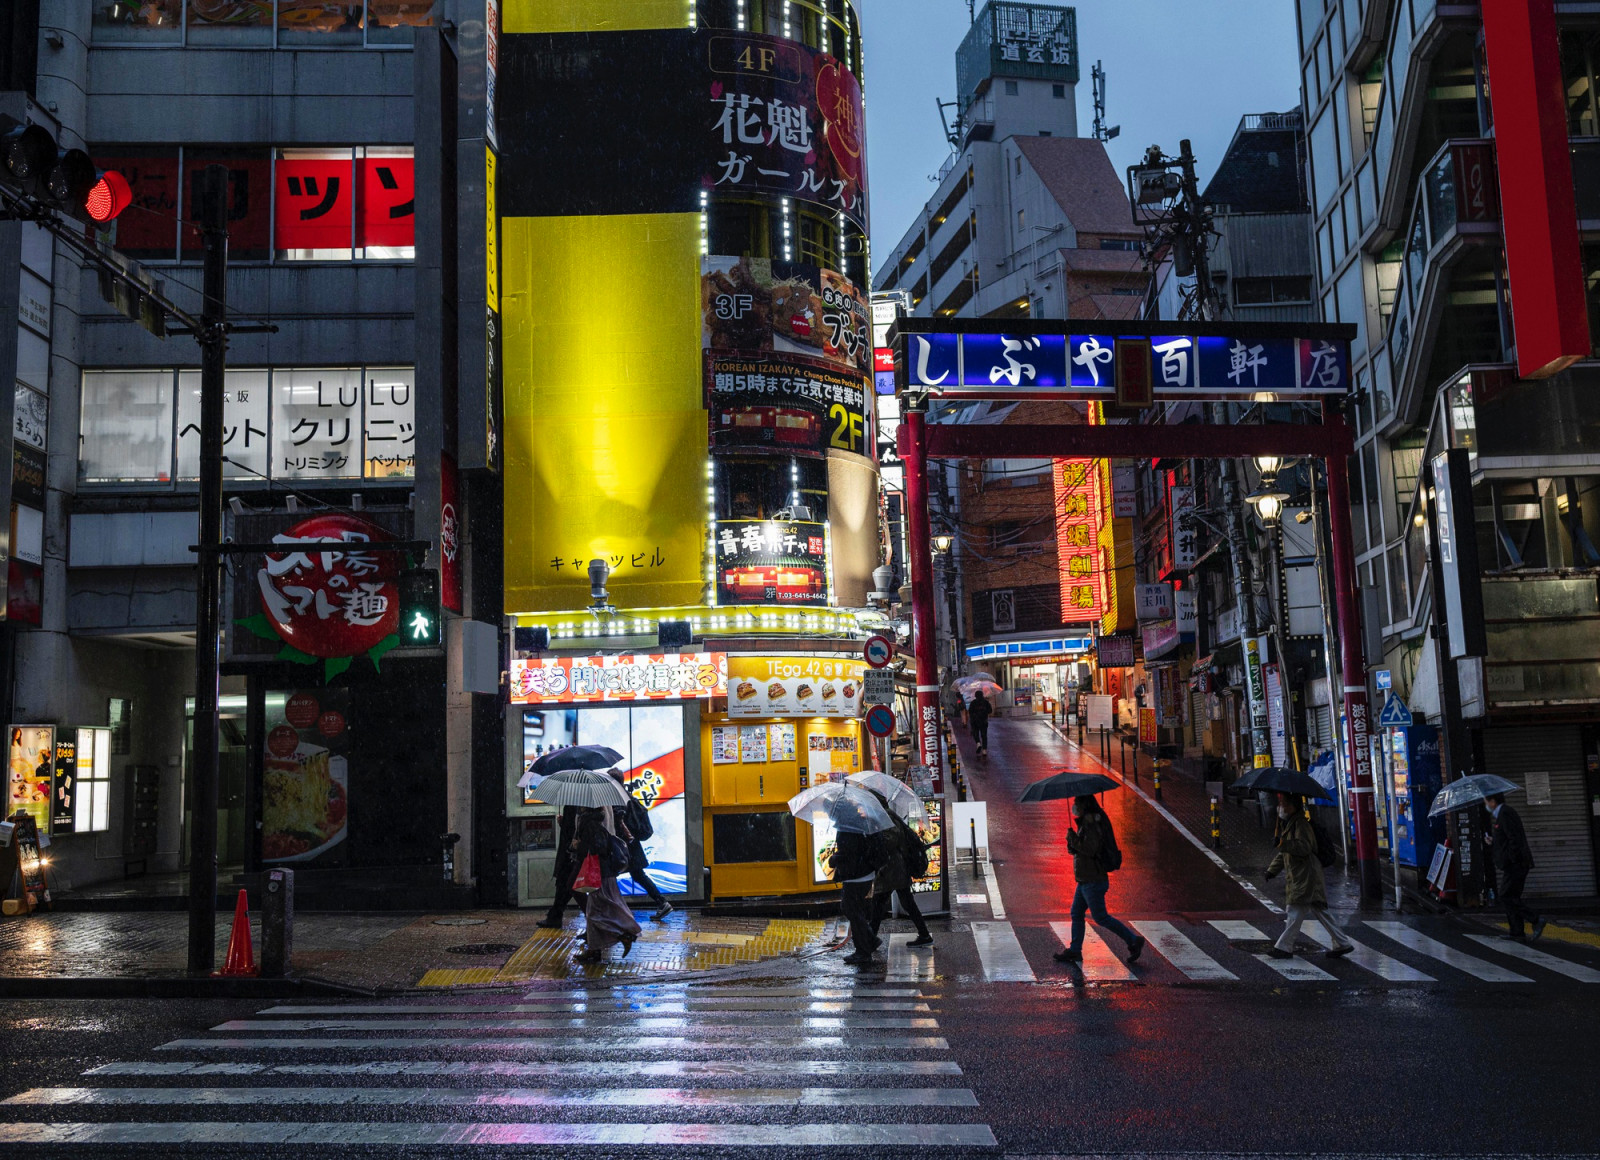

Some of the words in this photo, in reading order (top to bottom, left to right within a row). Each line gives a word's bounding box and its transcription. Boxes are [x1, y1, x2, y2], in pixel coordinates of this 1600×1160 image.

[737, 46, 776, 72] 4F
[1001, 44, 1070, 65] 道玄坂
[710, 93, 814, 154] 花魁
[715, 294, 752, 320] 3F
[714, 362, 756, 373] KOREAN
[758, 364, 801, 377] IZAKAYA
[803, 370, 824, 382] Chung
[715, 373, 863, 408] 朝5時まで元気で営業中
[829, 403, 863, 450] 2F
[285, 456, 348, 471] トリミング
[550, 547, 665, 571] キャツビル
[327, 574, 349, 588] の
[765, 590, 776, 598] 2F
[1142, 595, 1166, 607] 玉川
[521, 663, 719, 695] 笑う門には福来る
[766, 660, 820, 678] TEgg.42
[923, 706, 940, 780] 渋谷百軒店
[1352, 704, 1371, 775] 渋谷百軒店
[932, 882, 940, 891] 2F
